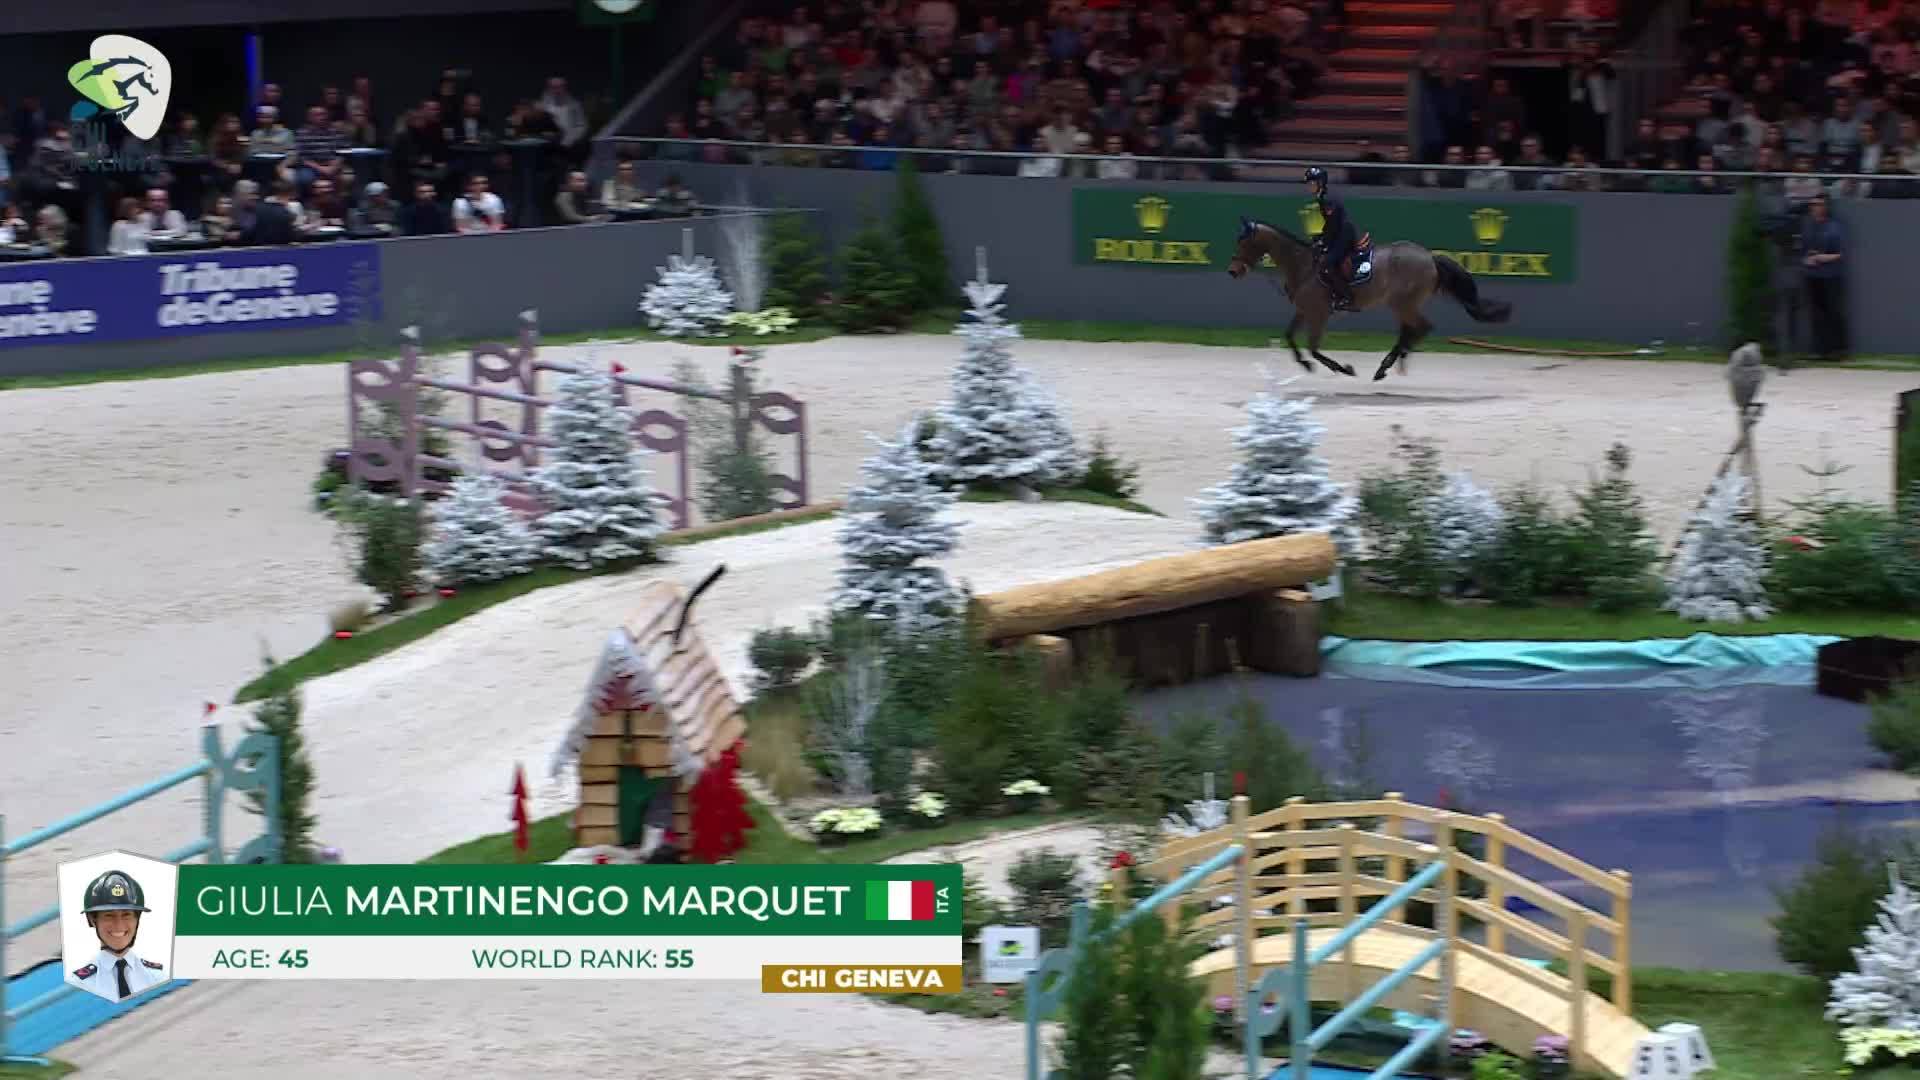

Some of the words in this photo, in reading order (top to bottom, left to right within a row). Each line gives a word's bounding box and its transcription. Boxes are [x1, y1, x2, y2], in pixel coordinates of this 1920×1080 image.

[1094, 238, 1212, 264] ROLEX
[1432, 250, 1552, 275] OLEX
[158, 262, 298, 295] Tribune
